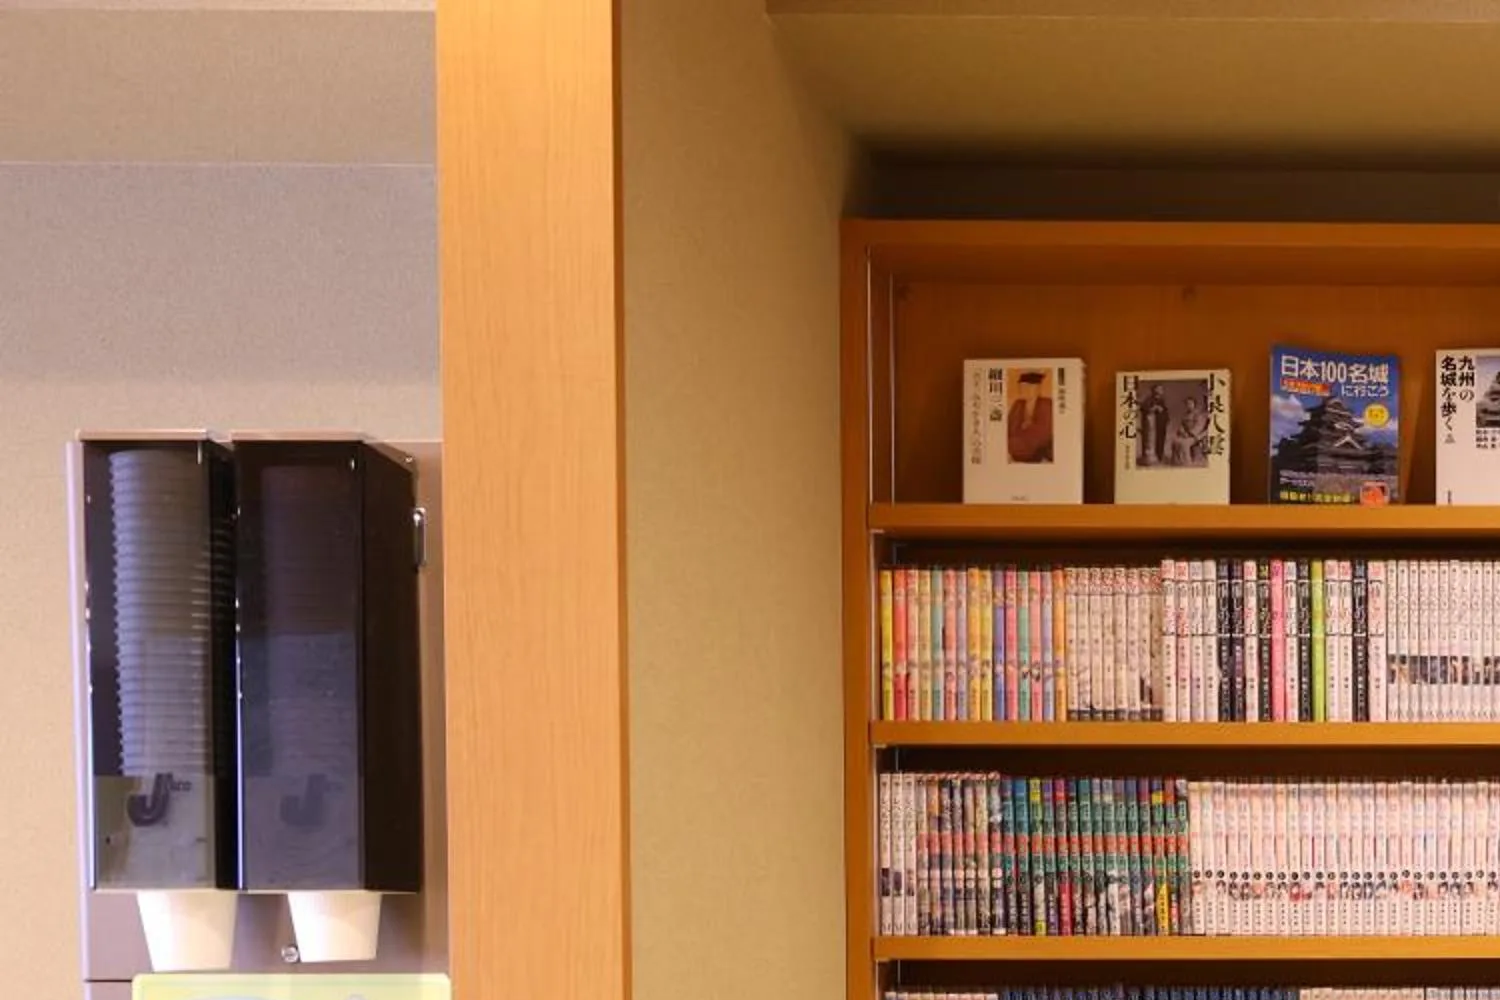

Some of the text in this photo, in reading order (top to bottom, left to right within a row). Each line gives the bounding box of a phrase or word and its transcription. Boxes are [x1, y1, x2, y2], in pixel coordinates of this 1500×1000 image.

[1280, 354, 1389, 383] 日本100名城
[1458, 355, 1475, 401] 九州の
[1440, 355, 1457, 432] 名城を歩く
